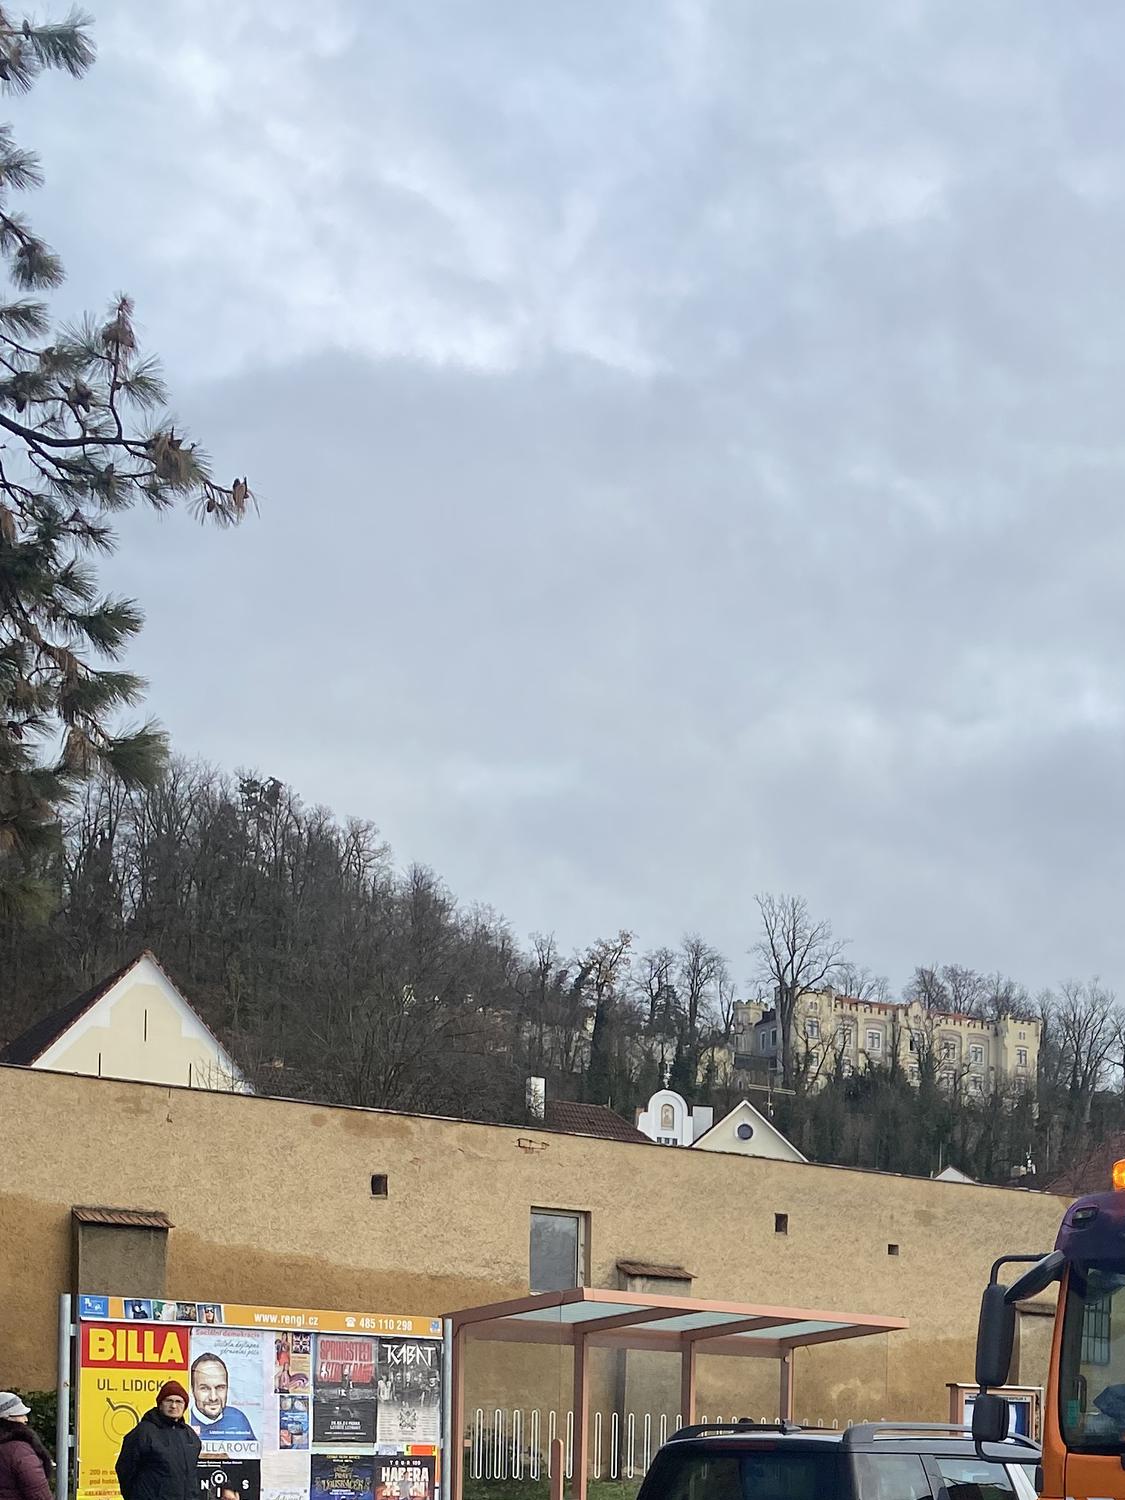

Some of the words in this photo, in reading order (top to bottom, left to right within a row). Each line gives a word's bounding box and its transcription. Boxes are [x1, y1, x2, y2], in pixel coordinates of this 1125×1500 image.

[254, 1313, 319, 1326] www.rengl.cz
[359, 1317, 376, 1329] 485
[378, 1319, 394, 1330] 110
[89, 1328, 184, 1364] BILLA
[97, 1379, 118, 1392] UL.
[122, 1377, 168, 1392] LIDICK
[202, 1441, 259, 1453] LLÁROVCI
[381, 1466, 430, 1482] HABERA
